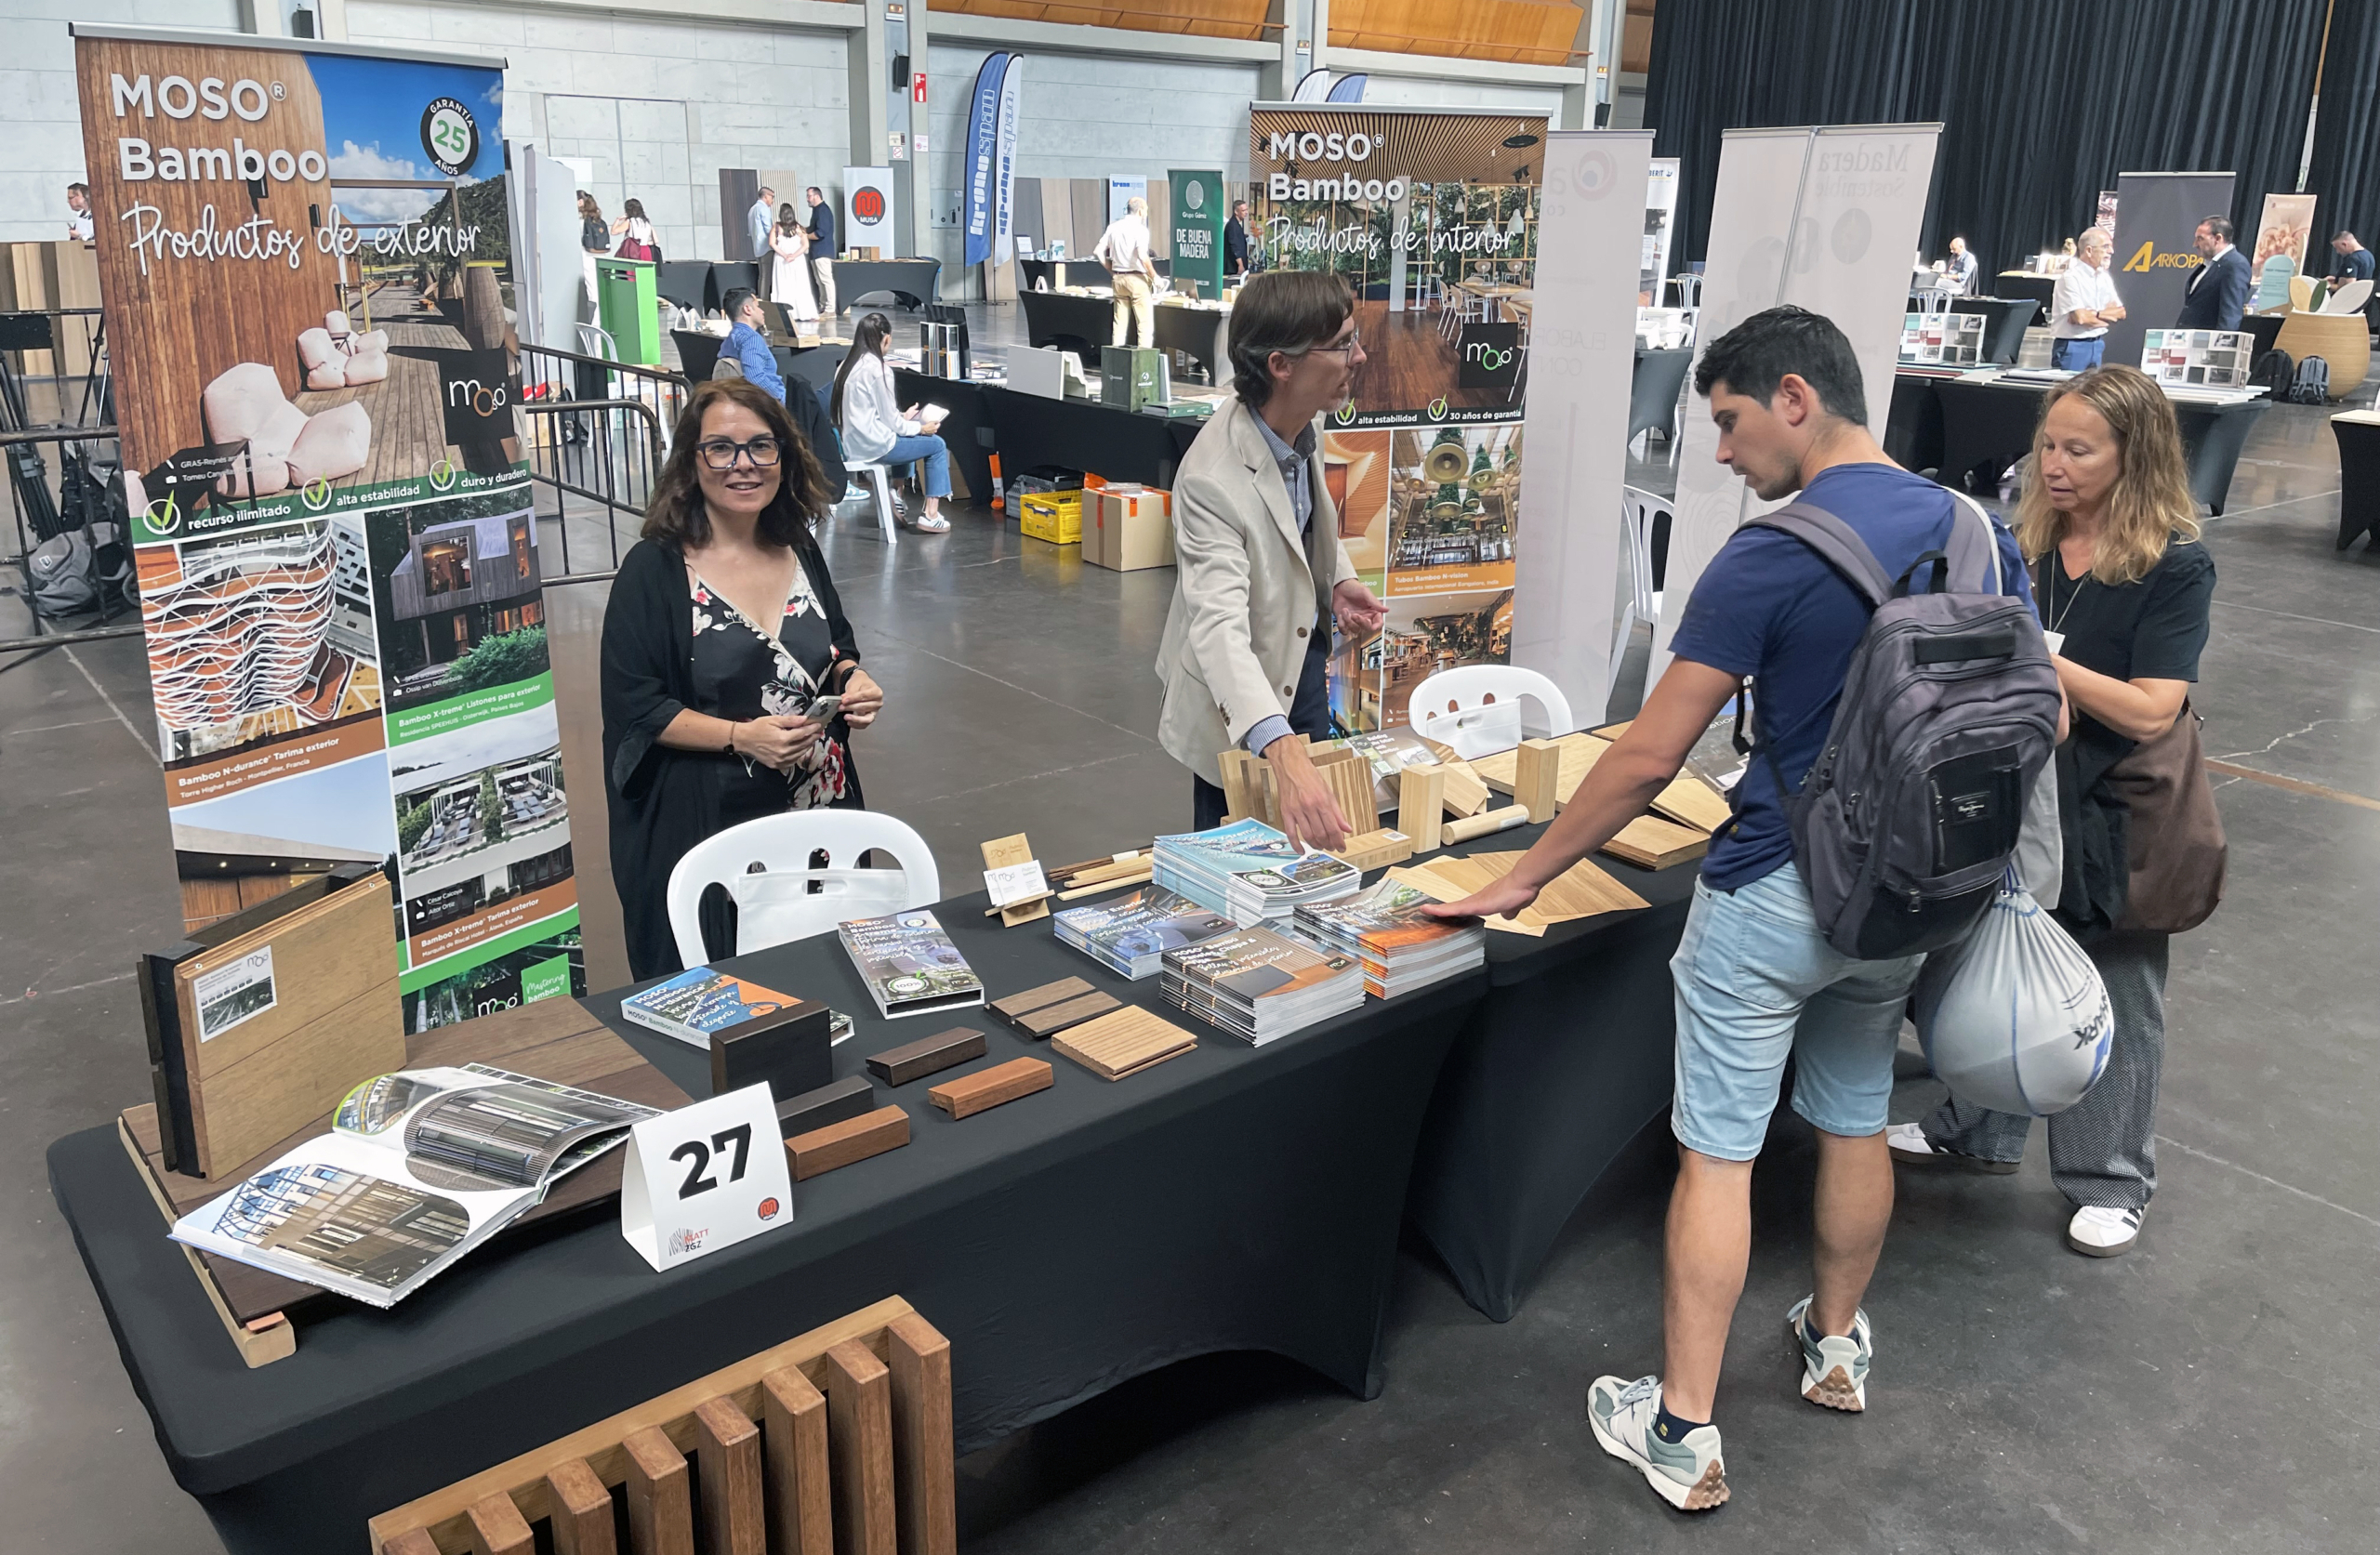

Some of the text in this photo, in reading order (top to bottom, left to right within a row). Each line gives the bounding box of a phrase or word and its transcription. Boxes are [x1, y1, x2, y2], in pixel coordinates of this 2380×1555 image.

[430, 99, 474, 128] GARANTÍA
[434, 119, 466, 153] 25
[118, 138, 327, 181] Bamboo
[434, 159, 458, 175] AÑOS
[1270, 172, 1405, 201] Bamboo
[122, 200, 482, 277] Productos de exterior
[1176, 229, 1211, 244] DE BUENA
[1265, 213, 1515, 261] Productos de interior
[1180, 243, 1210, 259] MADERA
[1358, 414, 1418, 425] alta estabilidad
[1449, 411, 1521, 420] 30 años de garantía
[182, 472, 205, 481] Tomeu
[460, 468, 526, 488] duro y duradero
[337, 484, 420, 507] alta estabilidad
[188, 505, 291, 530] recurso ilimitado
[399, 714, 431, 728] Bamboo
[467, 695, 496, 709] Listones
[497, 692, 515, 703] para
[517, 684, 541, 697] exterior
[400, 726, 430, 738] Residencia
[431, 718, 459, 730] SPEEHUIS
[509, 701, 523, 709] Bajos
[178, 771, 221, 787] Bamboo
[273, 746, 304, 761] Tarima
[306, 738, 339, 753] exterior
[180, 789, 200, 798] Torre
[202, 783, 225, 795] Higher
[226, 777, 243, 787] Roch
[286, 758, 310, 770] Francia
[1070, 908, 1108, 921] Bamboo
[1109, 898, 1146, 912] Exterior
[421, 931, 453, 947] Bamboo
[487, 909, 510, 922] Tarima
[511, 899, 539, 913] exterior
[850, 924, 895, 933] Bamboo
[454, 936, 469, 944] Riscal
[470, 930, 484, 939] Hotel
[1219, 941, 1248, 953] Chapa
[526, 973, 565, 994] Mastering
[528, 986, 560, 1003] bamboo
[643, 987, 687, 1008] Bamboo
[648, 1017, 673, 1031] Bamboo
[668, 1122, 751, 1201] 27
[684, 1240, 702, 1253] ZGZ
